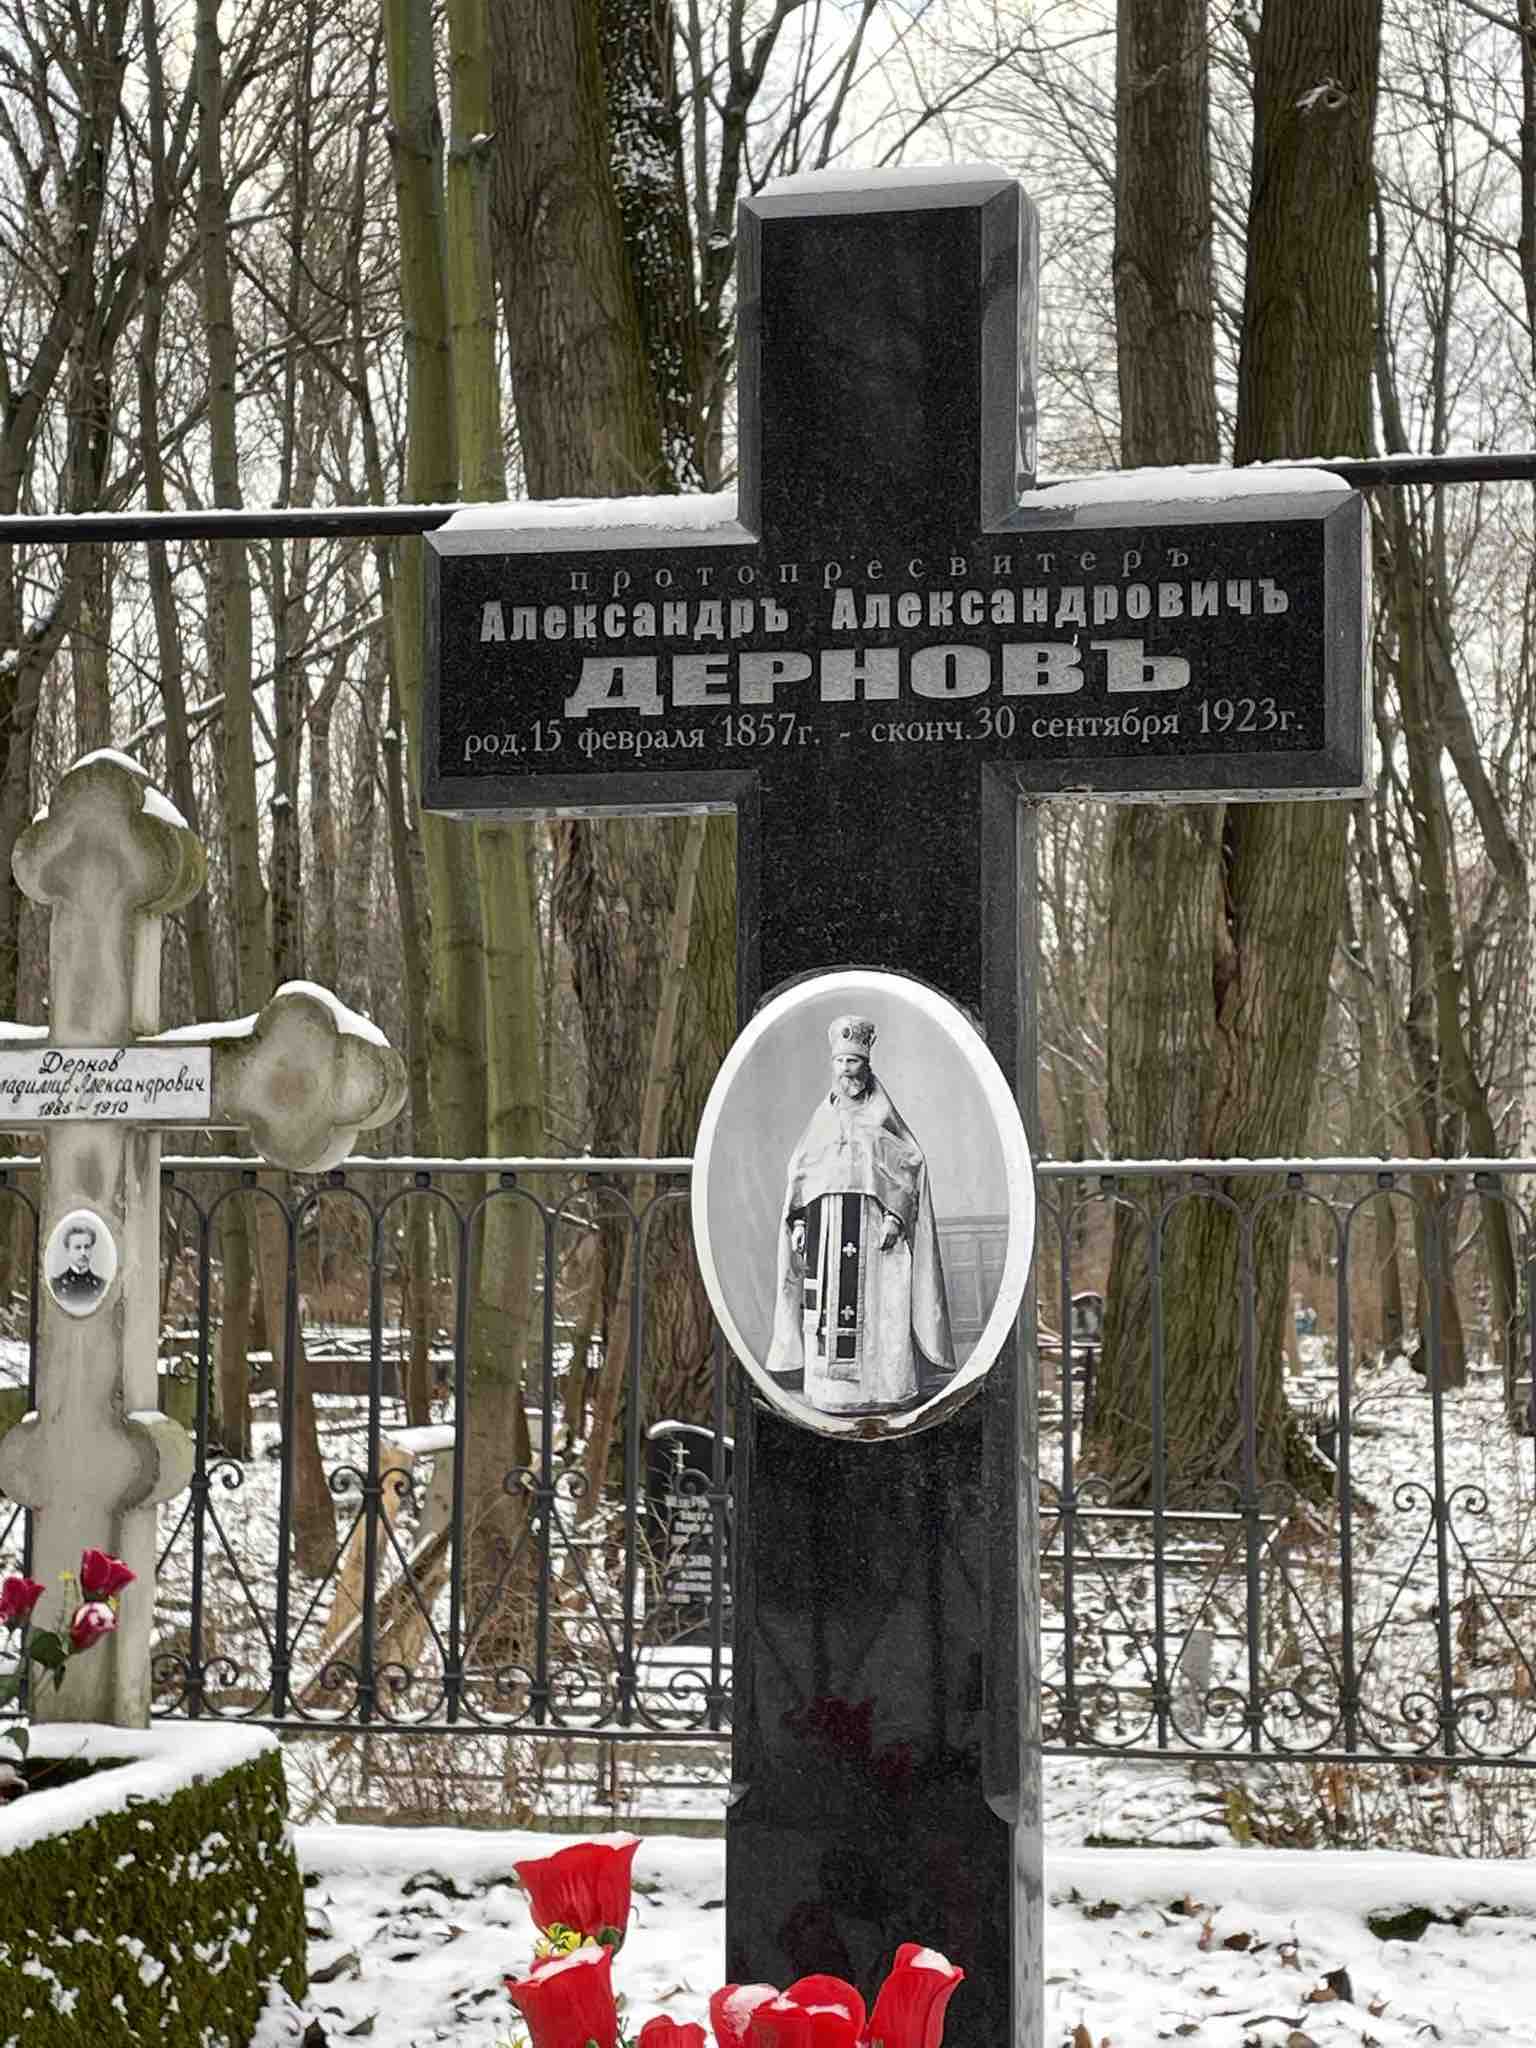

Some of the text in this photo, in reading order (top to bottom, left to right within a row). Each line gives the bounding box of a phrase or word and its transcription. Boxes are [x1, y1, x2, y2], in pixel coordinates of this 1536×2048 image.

[570, 549, 1189, 597] протопресвитеръ
[480, 578, 1289, 642] Александръ Александровичъ
[564, 638, 1191, 718] ДЕРНОВЪ
[577, 726, 706, 758] февраля
[720, 711, 821, 747] 1857г.
[1031, 707, 1180, 744] сентября
[1198, 697, 1304, 734] 1923г.
[38, 1049, 126, 1081] Дернов
